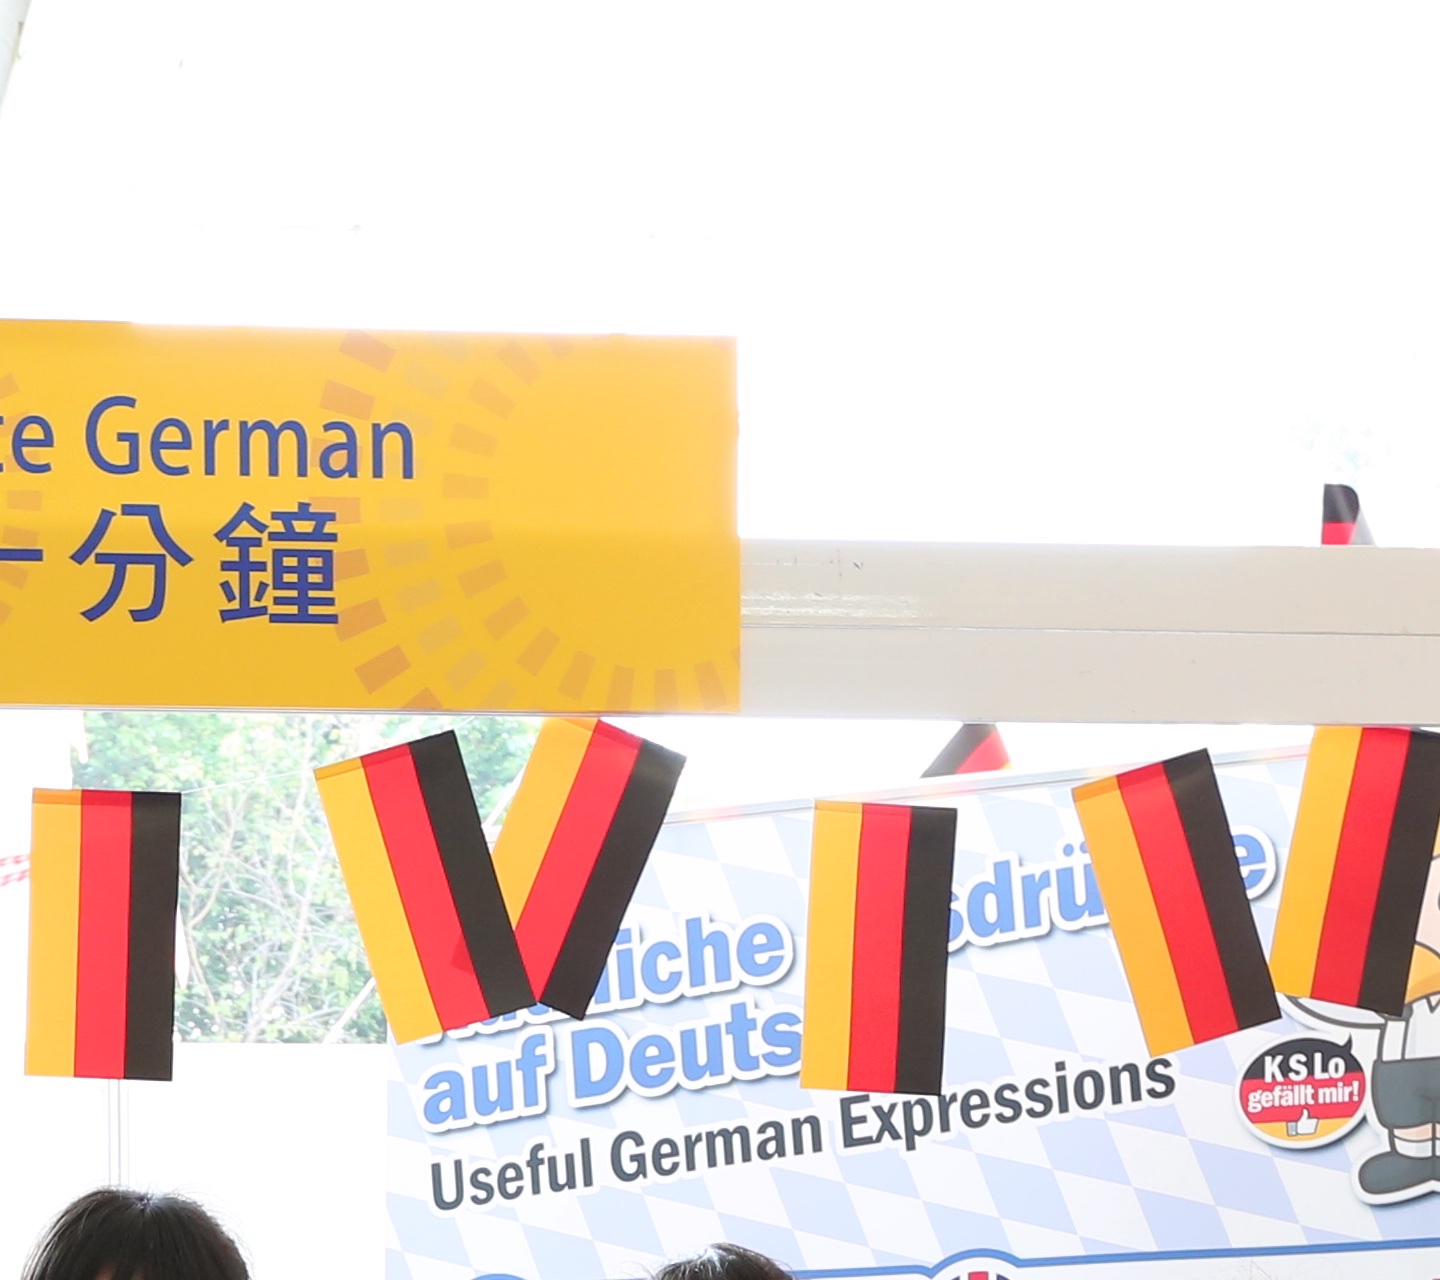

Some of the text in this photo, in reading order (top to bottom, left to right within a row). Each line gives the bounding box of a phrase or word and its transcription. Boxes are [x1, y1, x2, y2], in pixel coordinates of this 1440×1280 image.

[84, 394, 416, 481] German
[422, 1001, 804, 1125] auf Deuts
[1247, 1080, 1359, 1113] gefällt mir!
[431, 1057, 1176, 1212] Useful German Expressions
